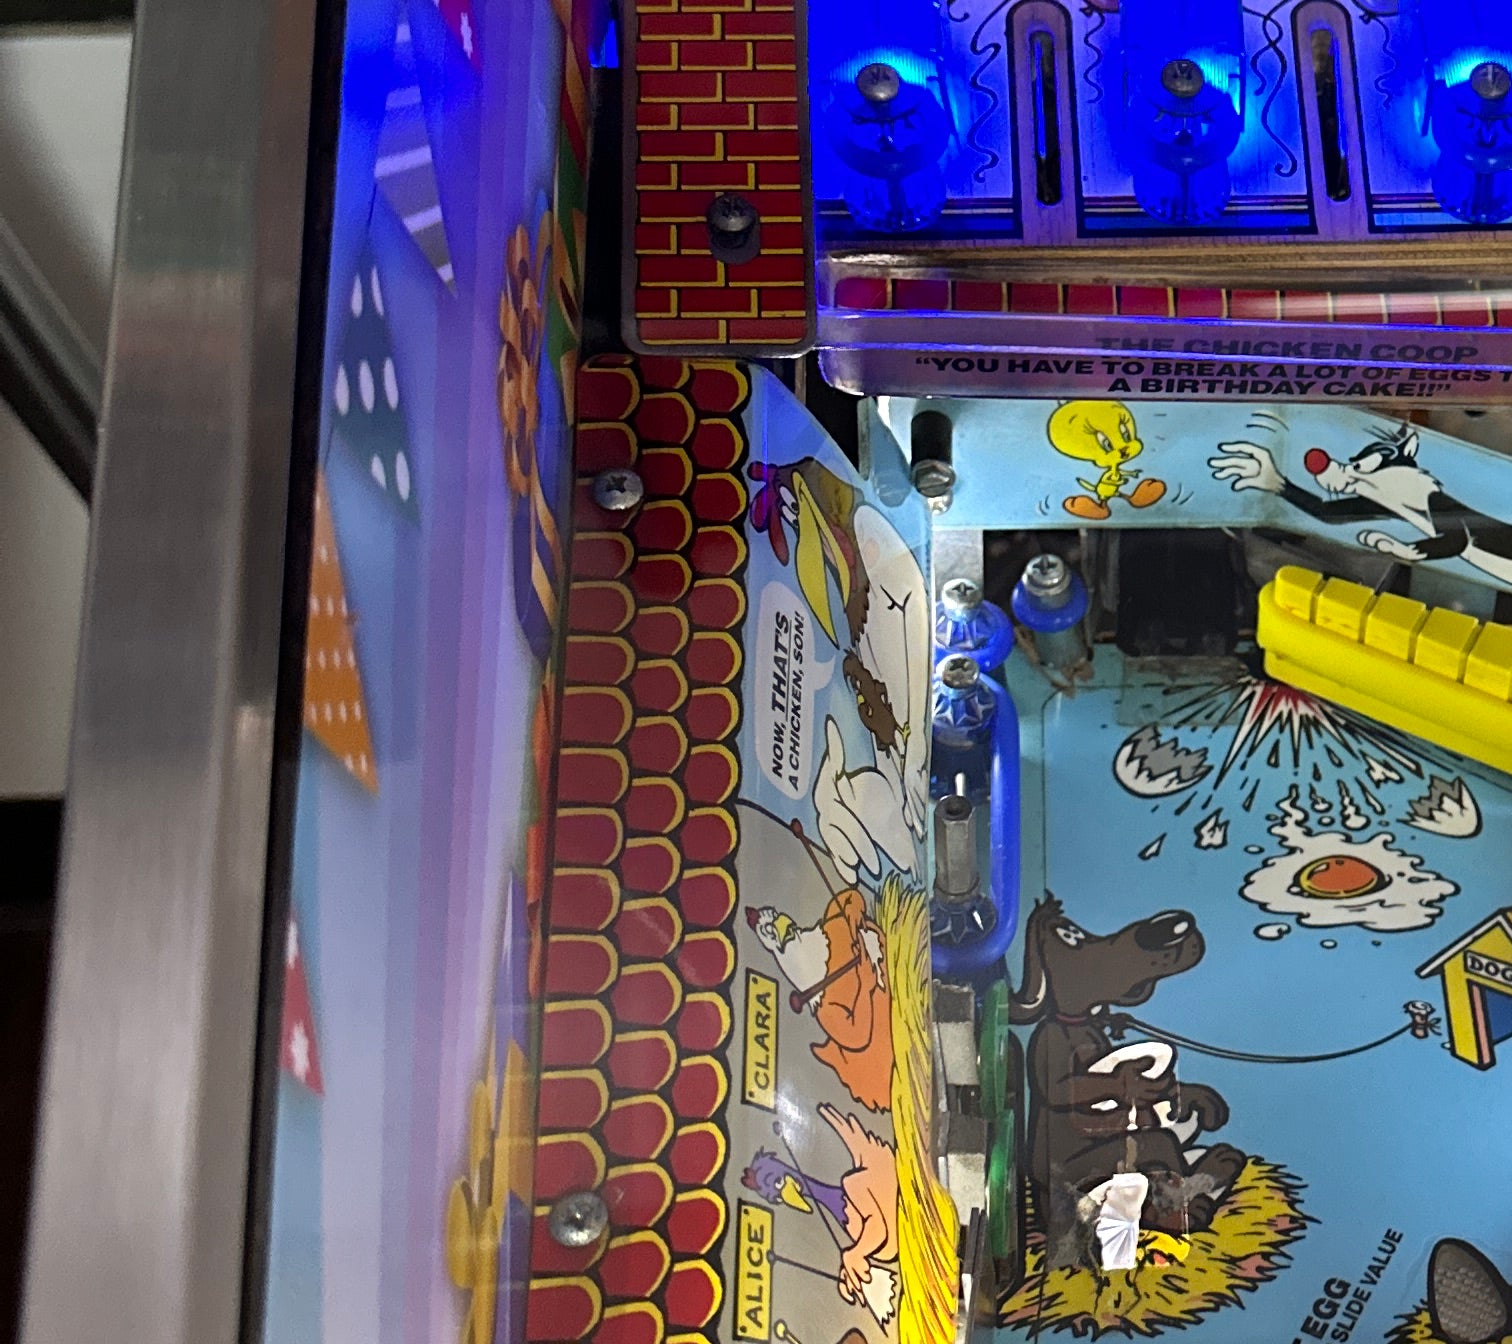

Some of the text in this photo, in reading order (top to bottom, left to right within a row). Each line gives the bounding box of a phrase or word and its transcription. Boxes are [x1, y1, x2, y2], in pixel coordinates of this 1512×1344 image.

[1007, 359, 1095, 375] HAVE
[1101, 360, 1145, 376] TO
[1151, 361, 1259, 378] BREAK
[1266, 363, 1290, 379] A
[1295, 365, 1357, 380] LOT
[1361, 367, 1409, 382] OF
[1408, 368, 1493, 383] EGGS
[1094, 337, 1480, 362] THE CHICKEN COOP
[1107, 377, 1131, 393] A
[1140, 378, 1317, 396] BIRTHDAY
[771, 611, 790, 779] NOW, THAT'S
[787, 610, 806, 792] A CHICKEN, SON!
[753, 991, 772, 1091] CLARA
[744, 1222, 765, 1329] ALICE
[1301, 1276, 1352, 1341] EGG
[1331, 1285, 1372, 1344] SLIDE
[1362, 1227, 1404, 1288] VALUE
